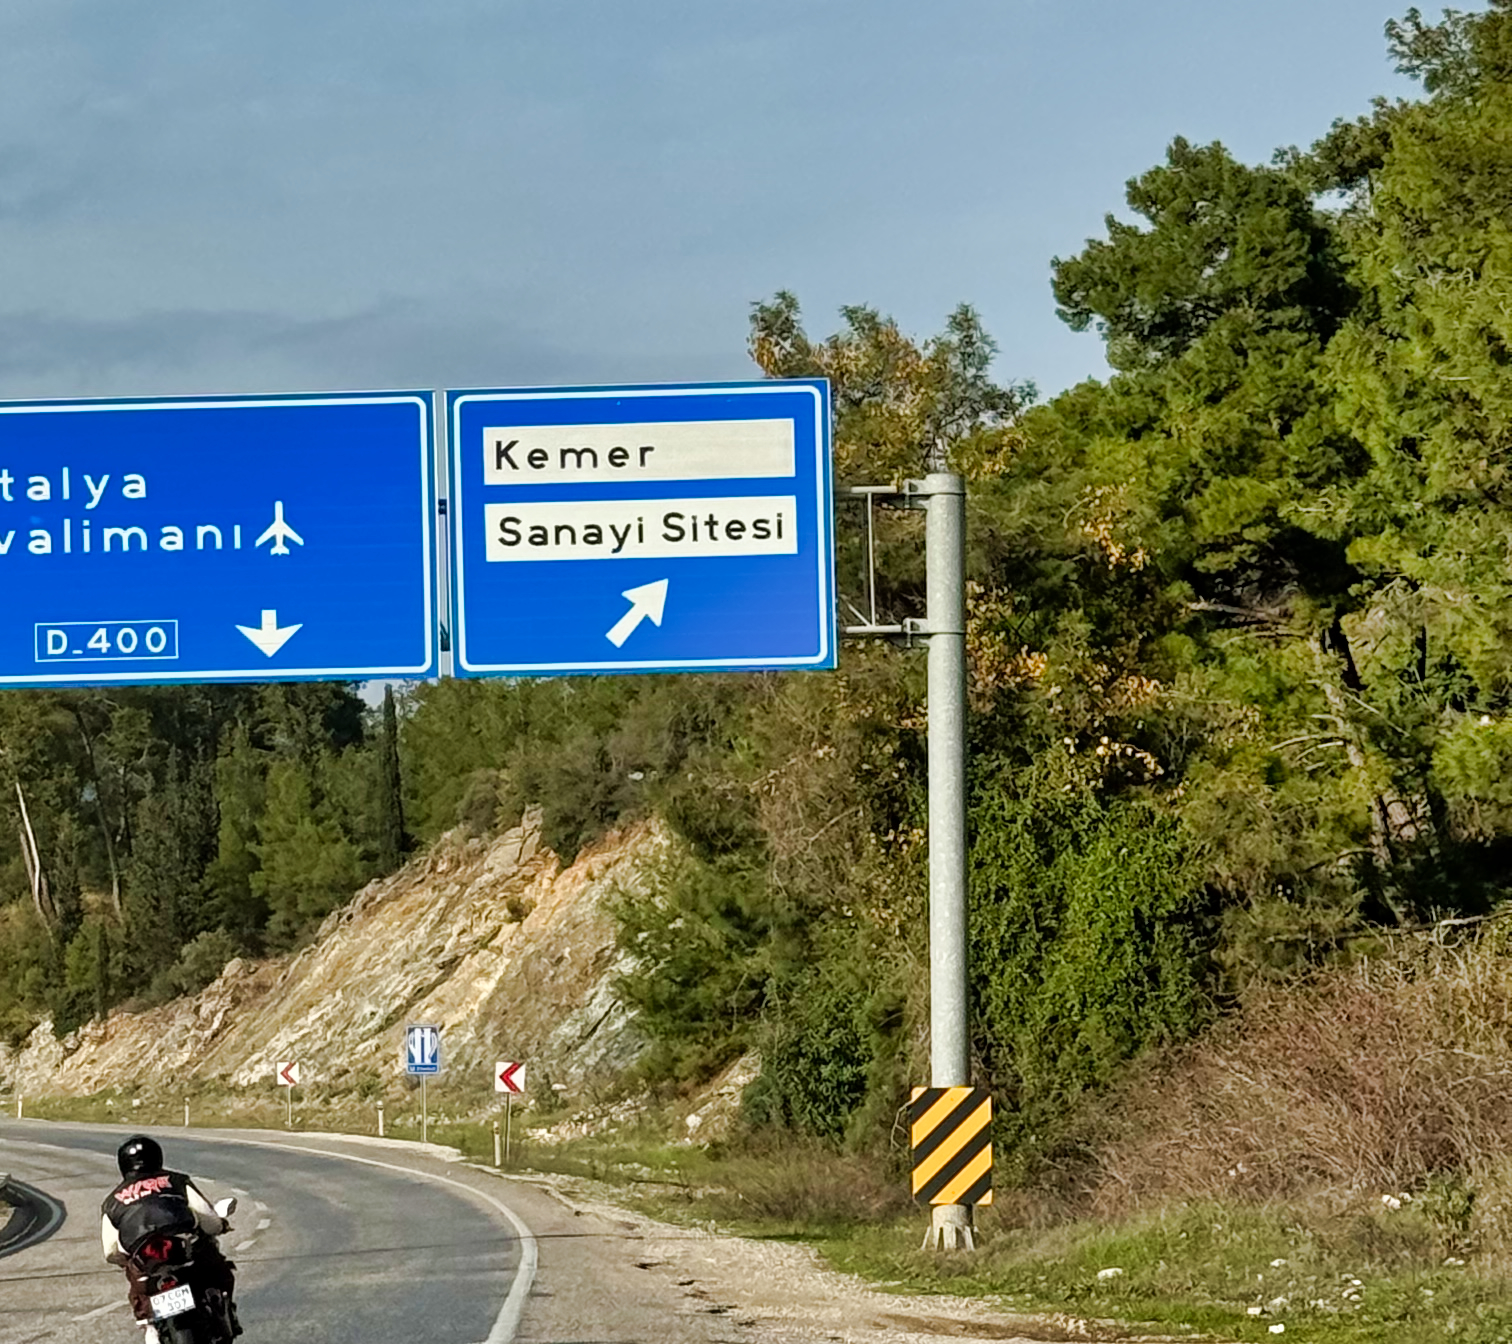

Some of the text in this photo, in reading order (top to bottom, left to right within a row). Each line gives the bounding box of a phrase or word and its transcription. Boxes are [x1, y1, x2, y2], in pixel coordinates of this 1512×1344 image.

[495, 439, 656, 471] Kemer
[498, 511, 785, 554] Sanayi Sitesi
